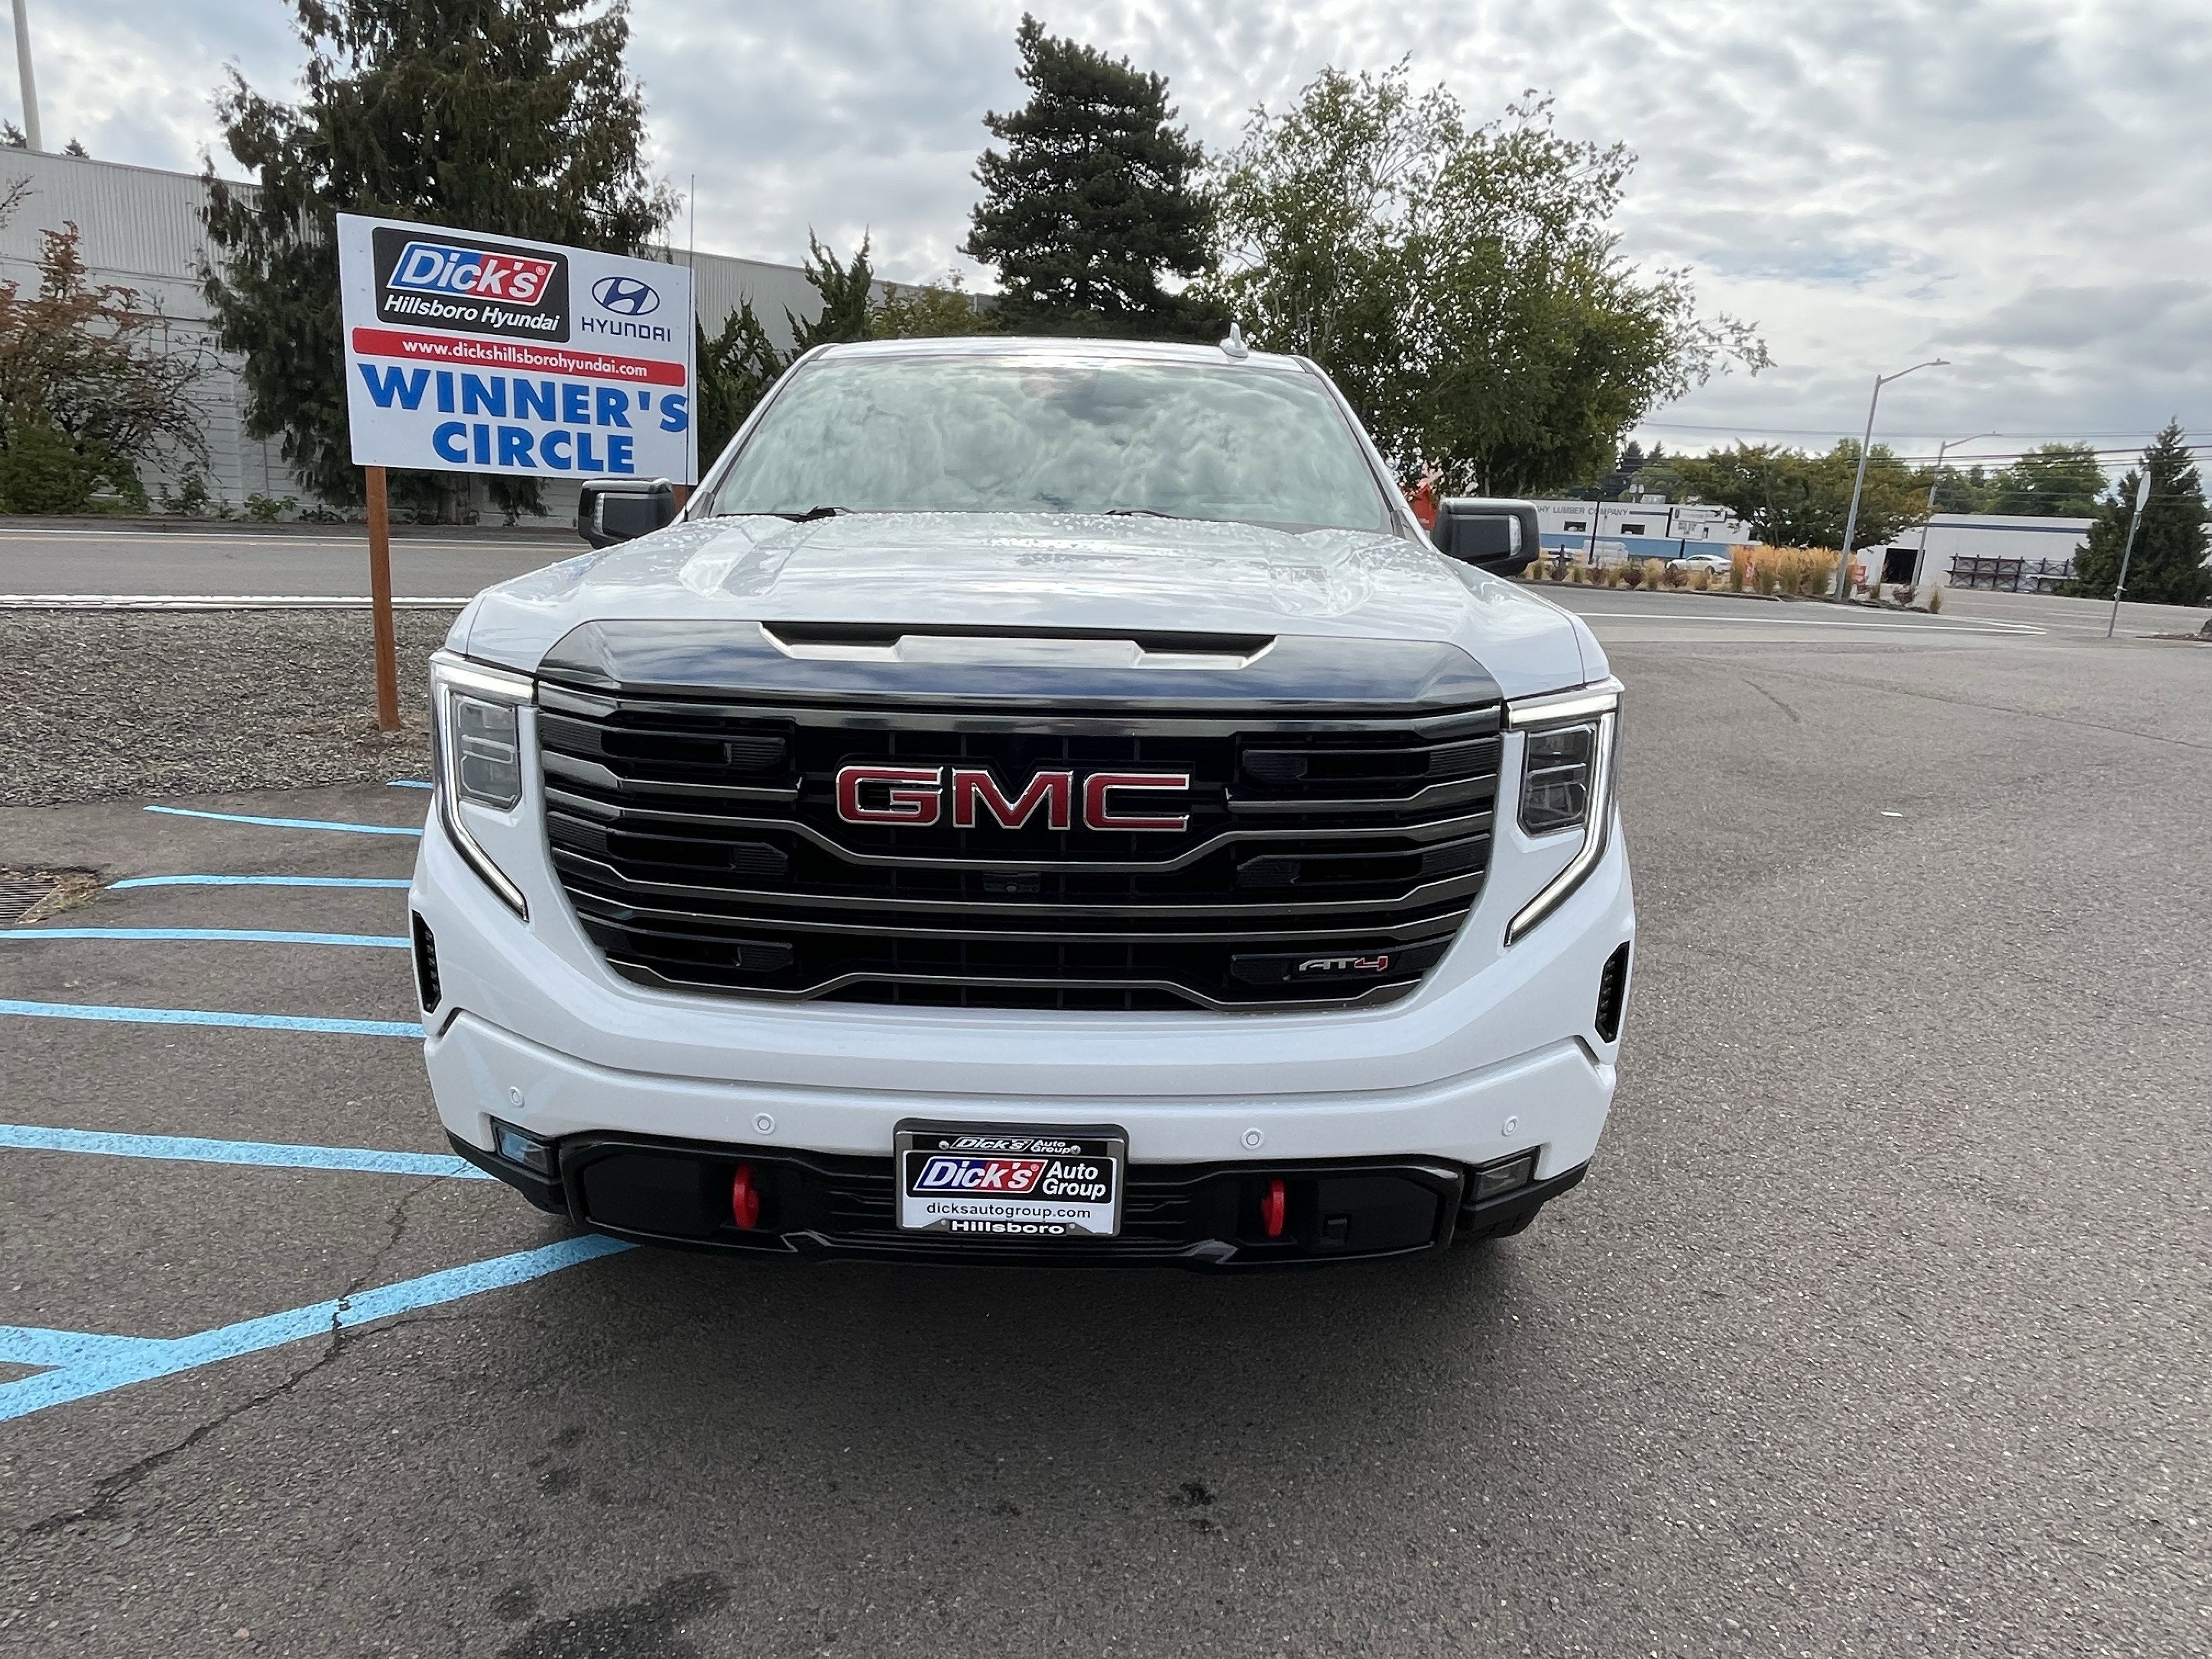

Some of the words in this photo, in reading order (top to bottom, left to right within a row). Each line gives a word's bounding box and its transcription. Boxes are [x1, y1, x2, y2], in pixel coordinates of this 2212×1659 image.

[401, 250, 538, 298] Dick's
[384, 295, 476, 321] Hillsboro
[481, 307, 560, 331] Hyundai
[582, 317, 670, 342] HYUNDAI
[403, 338, 647, 377] www.dickshillsborohyundai.com
[358, 363, 688, 432] WINNER'S
[433, 421, 635, 473] CIRCLE
[1553, 506, 1585, 514] LUMBER
[836, 766, 1189, 832] GMC
[1299, 956, 1388, 971] AT4
[956, 1139, 1025, 1149] Dick's
[923, 1161, 1032, 1188] Dick's
[1046, 1161, 1098, 1180] Auto
[1042, 1179, 1106, 1200] Group
[927, 1202, 1091, 1218] dicksautogroup.com
[952, 1220, 1064, 1234] Hillsboro
